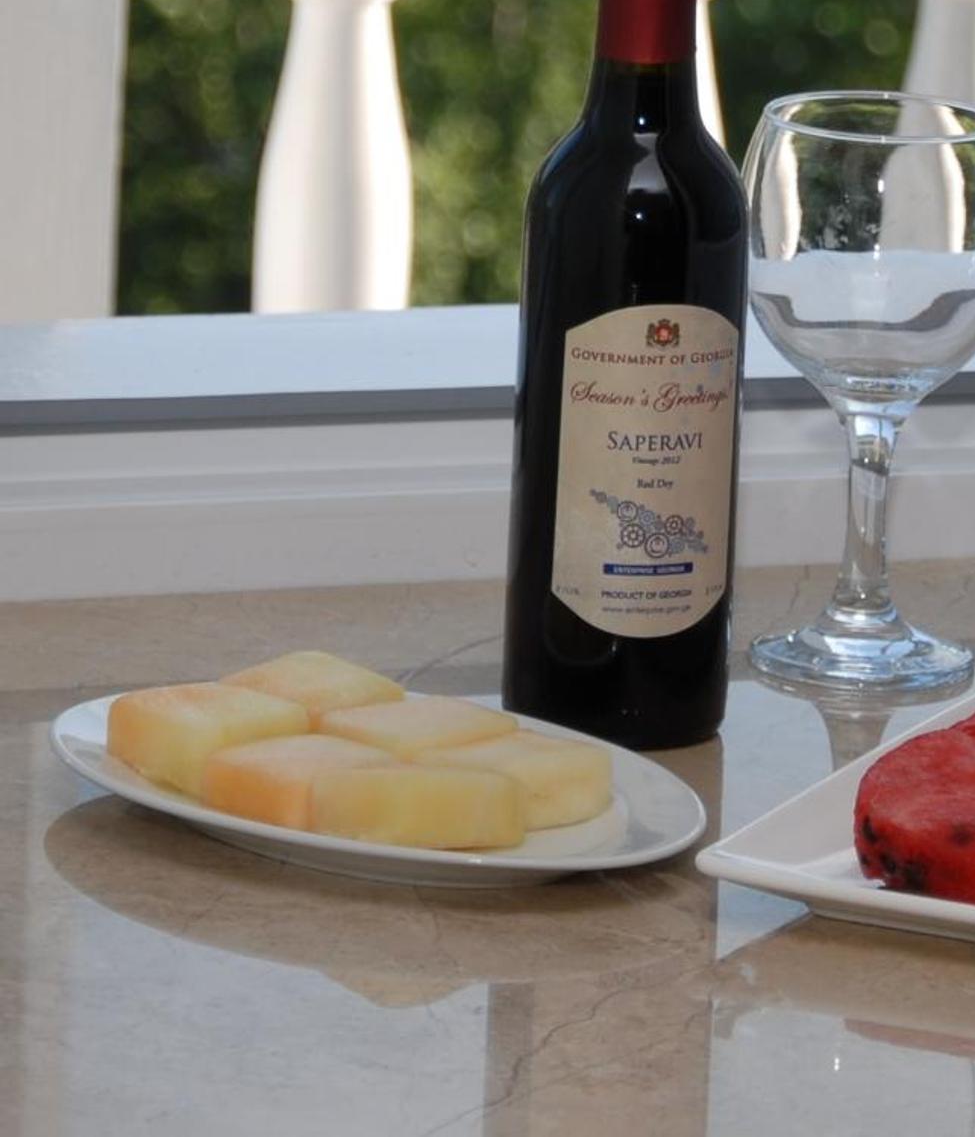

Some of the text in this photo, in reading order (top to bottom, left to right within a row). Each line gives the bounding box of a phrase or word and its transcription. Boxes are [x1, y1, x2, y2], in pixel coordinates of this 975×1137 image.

[571, 347, 666, 365] GOVERNMENT
[670, 354, 685, 365] OF
[570, 380, 649, 407] Season's
[606, 430, 703, 452] SAPERAVI
[660, 456, 681, 465] 2012
[637, 478, 674, 490] Red Dry
[601, 589, 692, 600] PRODUCT OF GEORGIA
